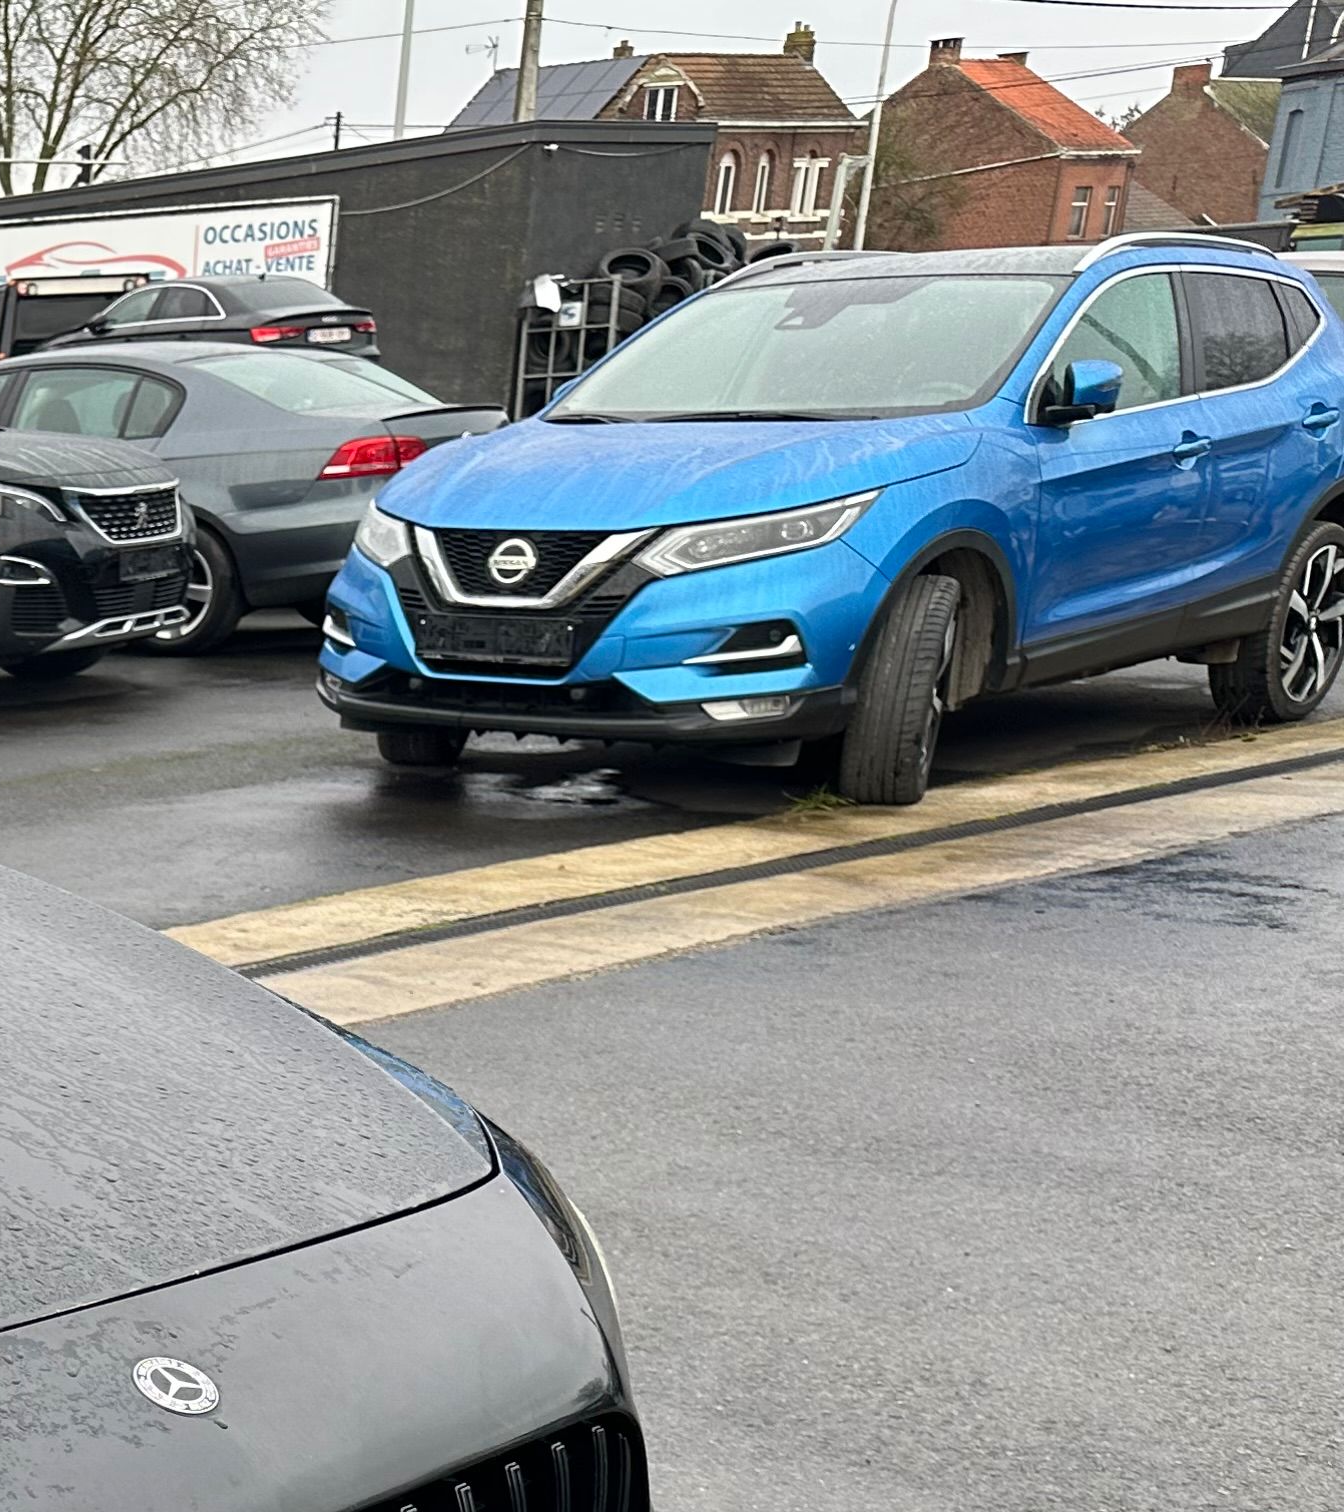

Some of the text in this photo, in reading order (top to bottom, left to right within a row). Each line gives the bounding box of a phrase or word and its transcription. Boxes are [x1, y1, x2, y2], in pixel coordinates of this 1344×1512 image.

[203, 218, 318, 245] OCCASIONS
[202, 258, 253, 276] ACHAT
[265, 255, 315, 272] VENTE
